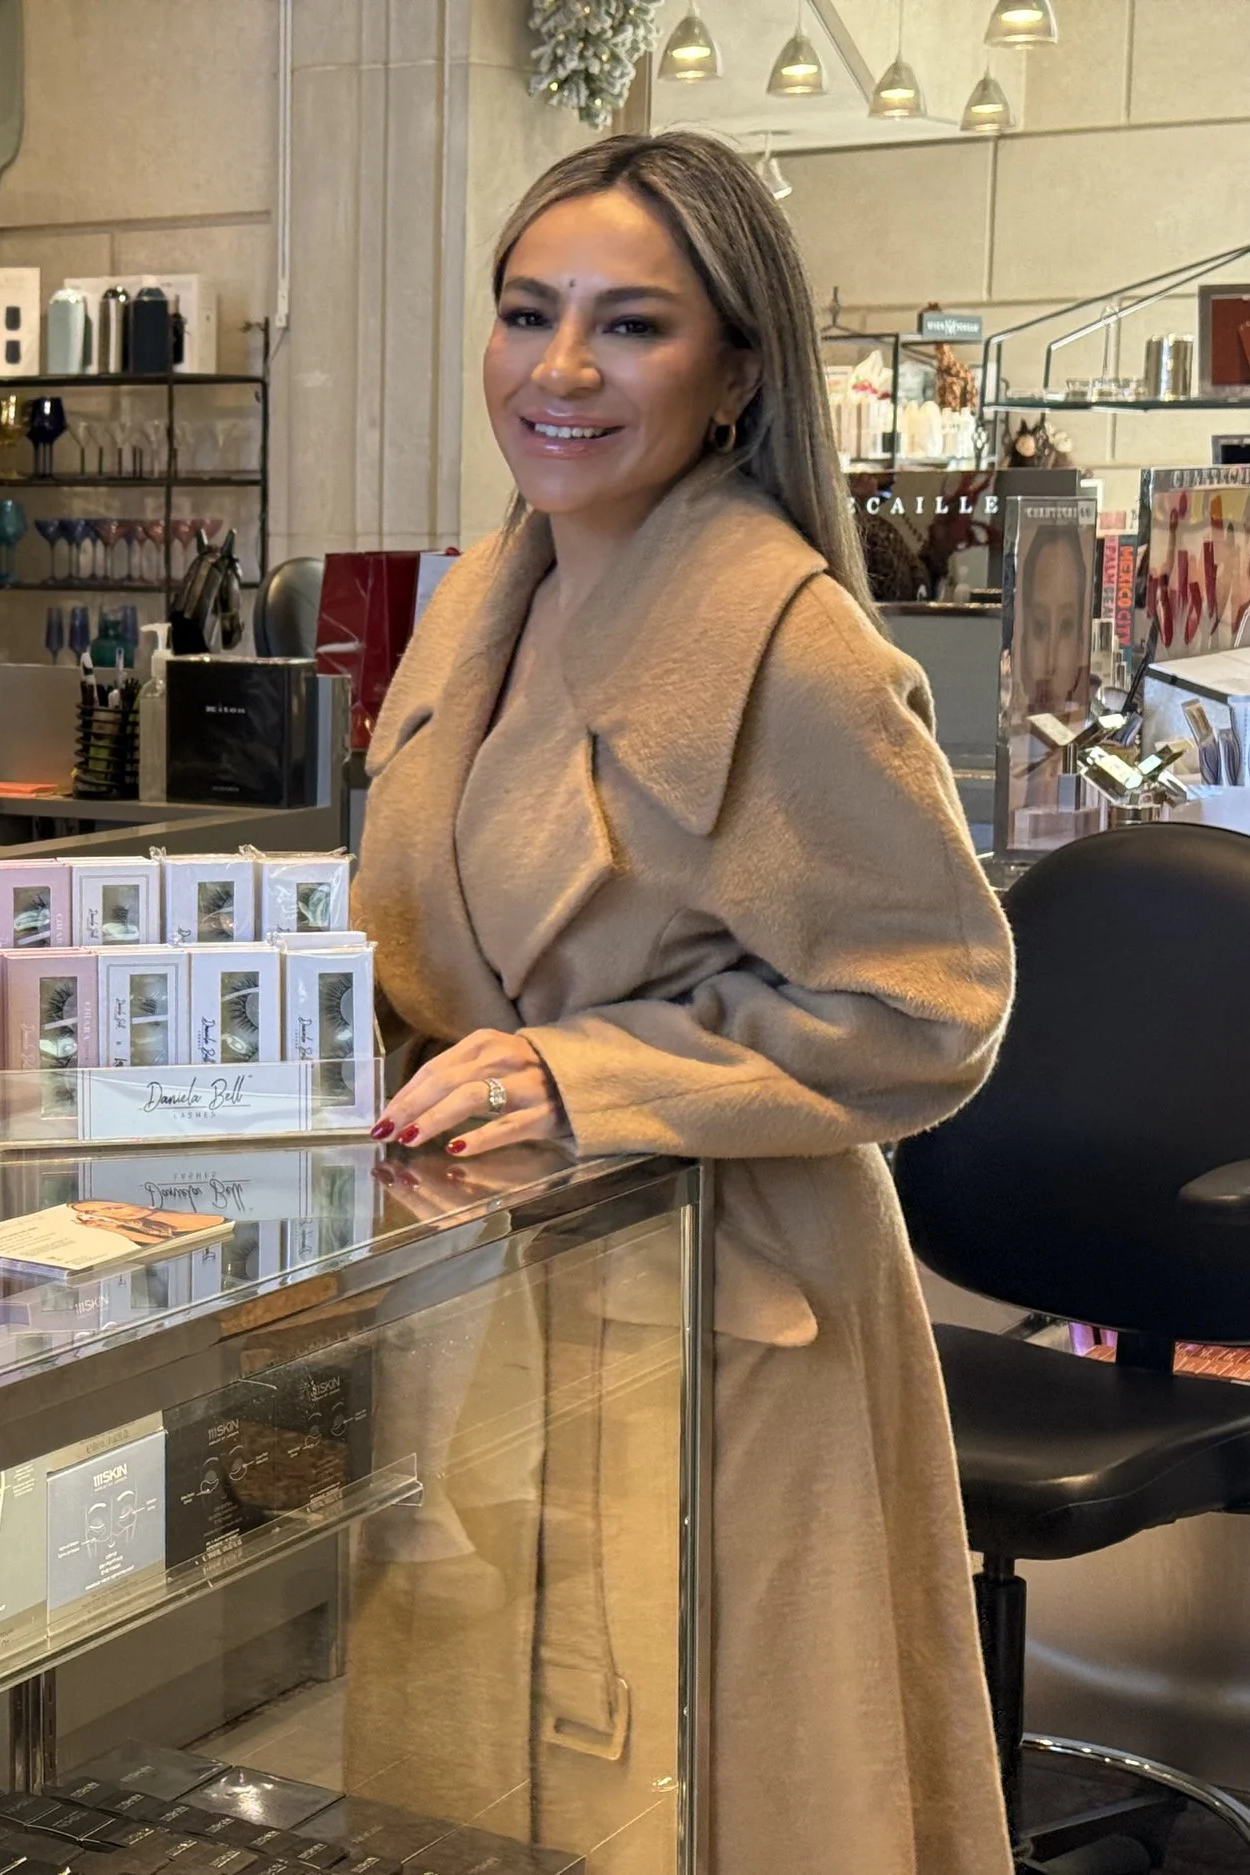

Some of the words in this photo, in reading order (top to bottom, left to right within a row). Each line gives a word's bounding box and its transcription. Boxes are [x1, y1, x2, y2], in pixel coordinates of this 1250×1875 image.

[1118, 545, 1135, 608] MEXICO
[1101, 586, 1115, 619] BEA
[1116, 608, 1132, 646] CITY
[143, 1076, 203, 1113] Daniela
[209, 1075, 246, 1111] Bell
[173, 1111, 217, 1120] LASHES
[92, 1462, 128, 1488] 111SKIN
